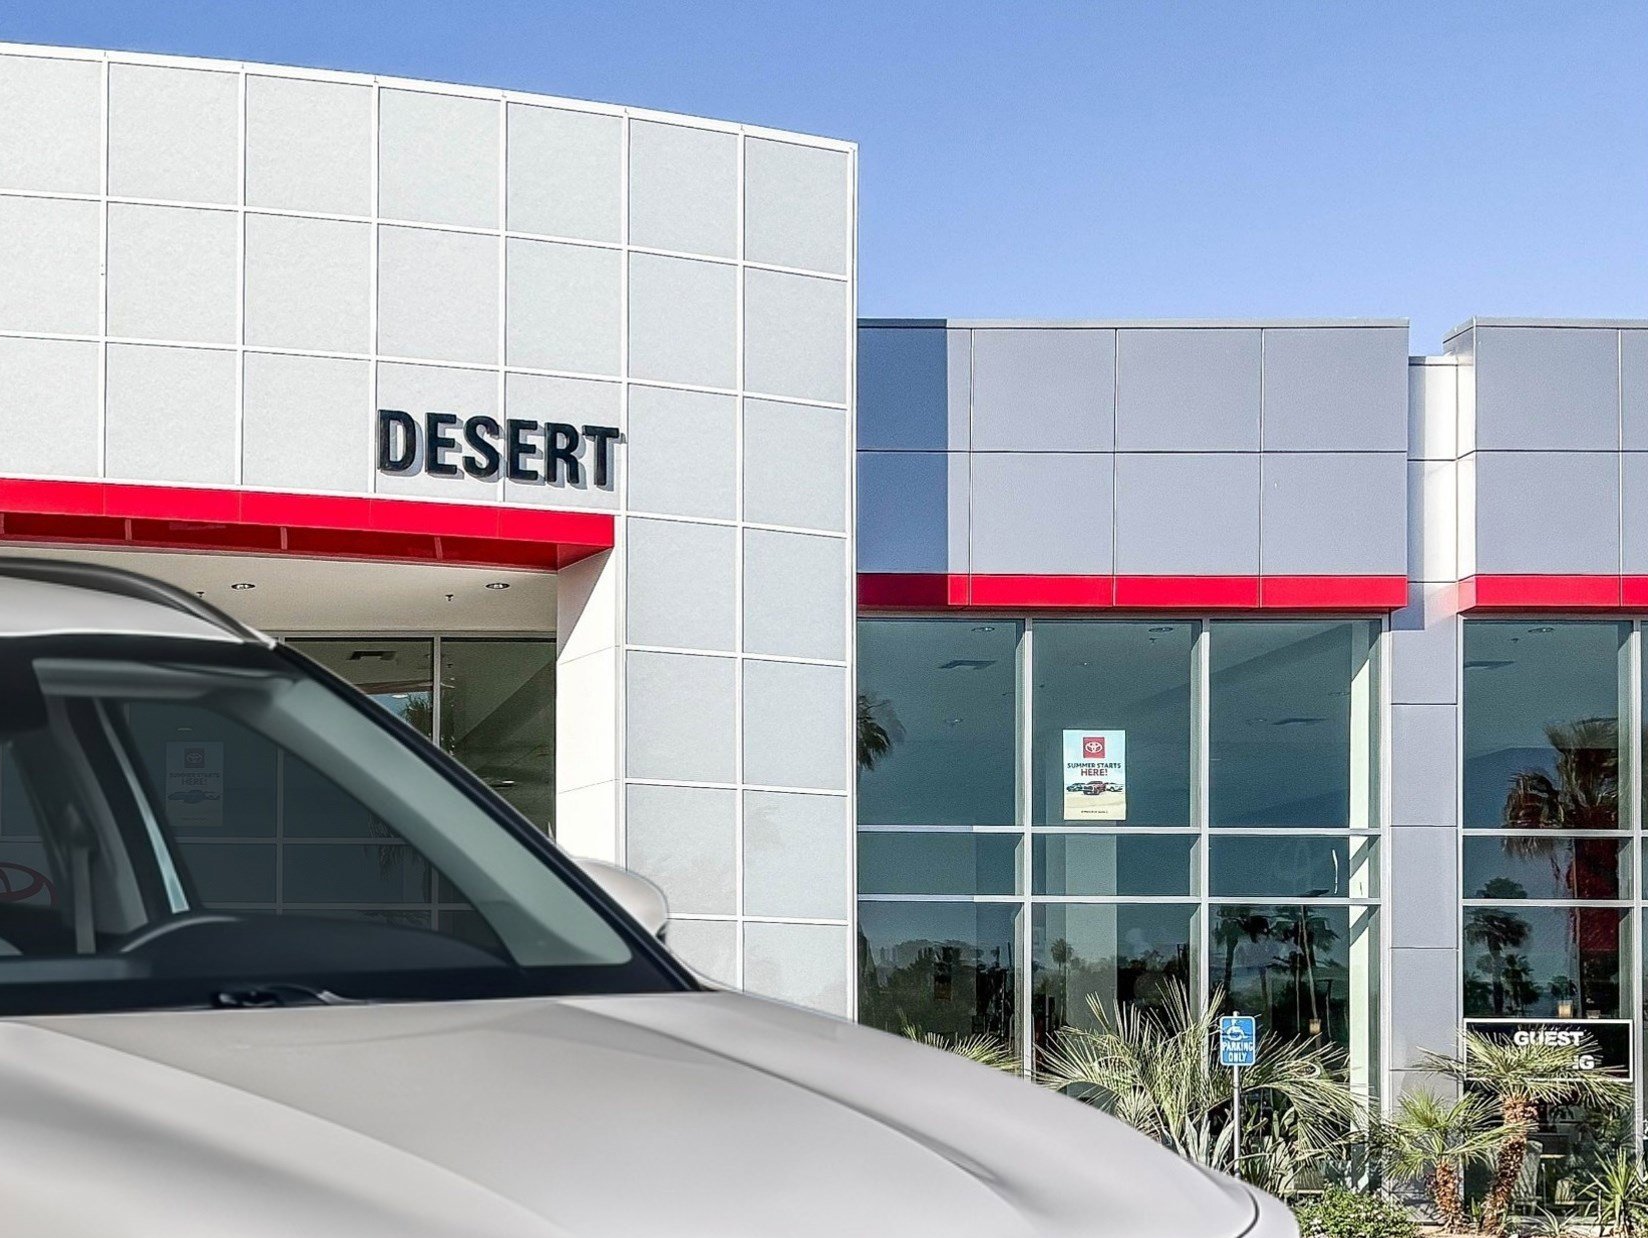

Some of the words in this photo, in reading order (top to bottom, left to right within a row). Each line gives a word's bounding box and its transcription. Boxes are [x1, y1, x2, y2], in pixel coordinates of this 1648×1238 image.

[376, 409, 620, 487] DESERT
[1081, 768, 1108, 777] HERE!
[1513, 1030, 1584, 1047] GUEST
[1222, 1041, 1254, 1051] PARKING
[1228, 1052, 1247, 1062] ONLY
